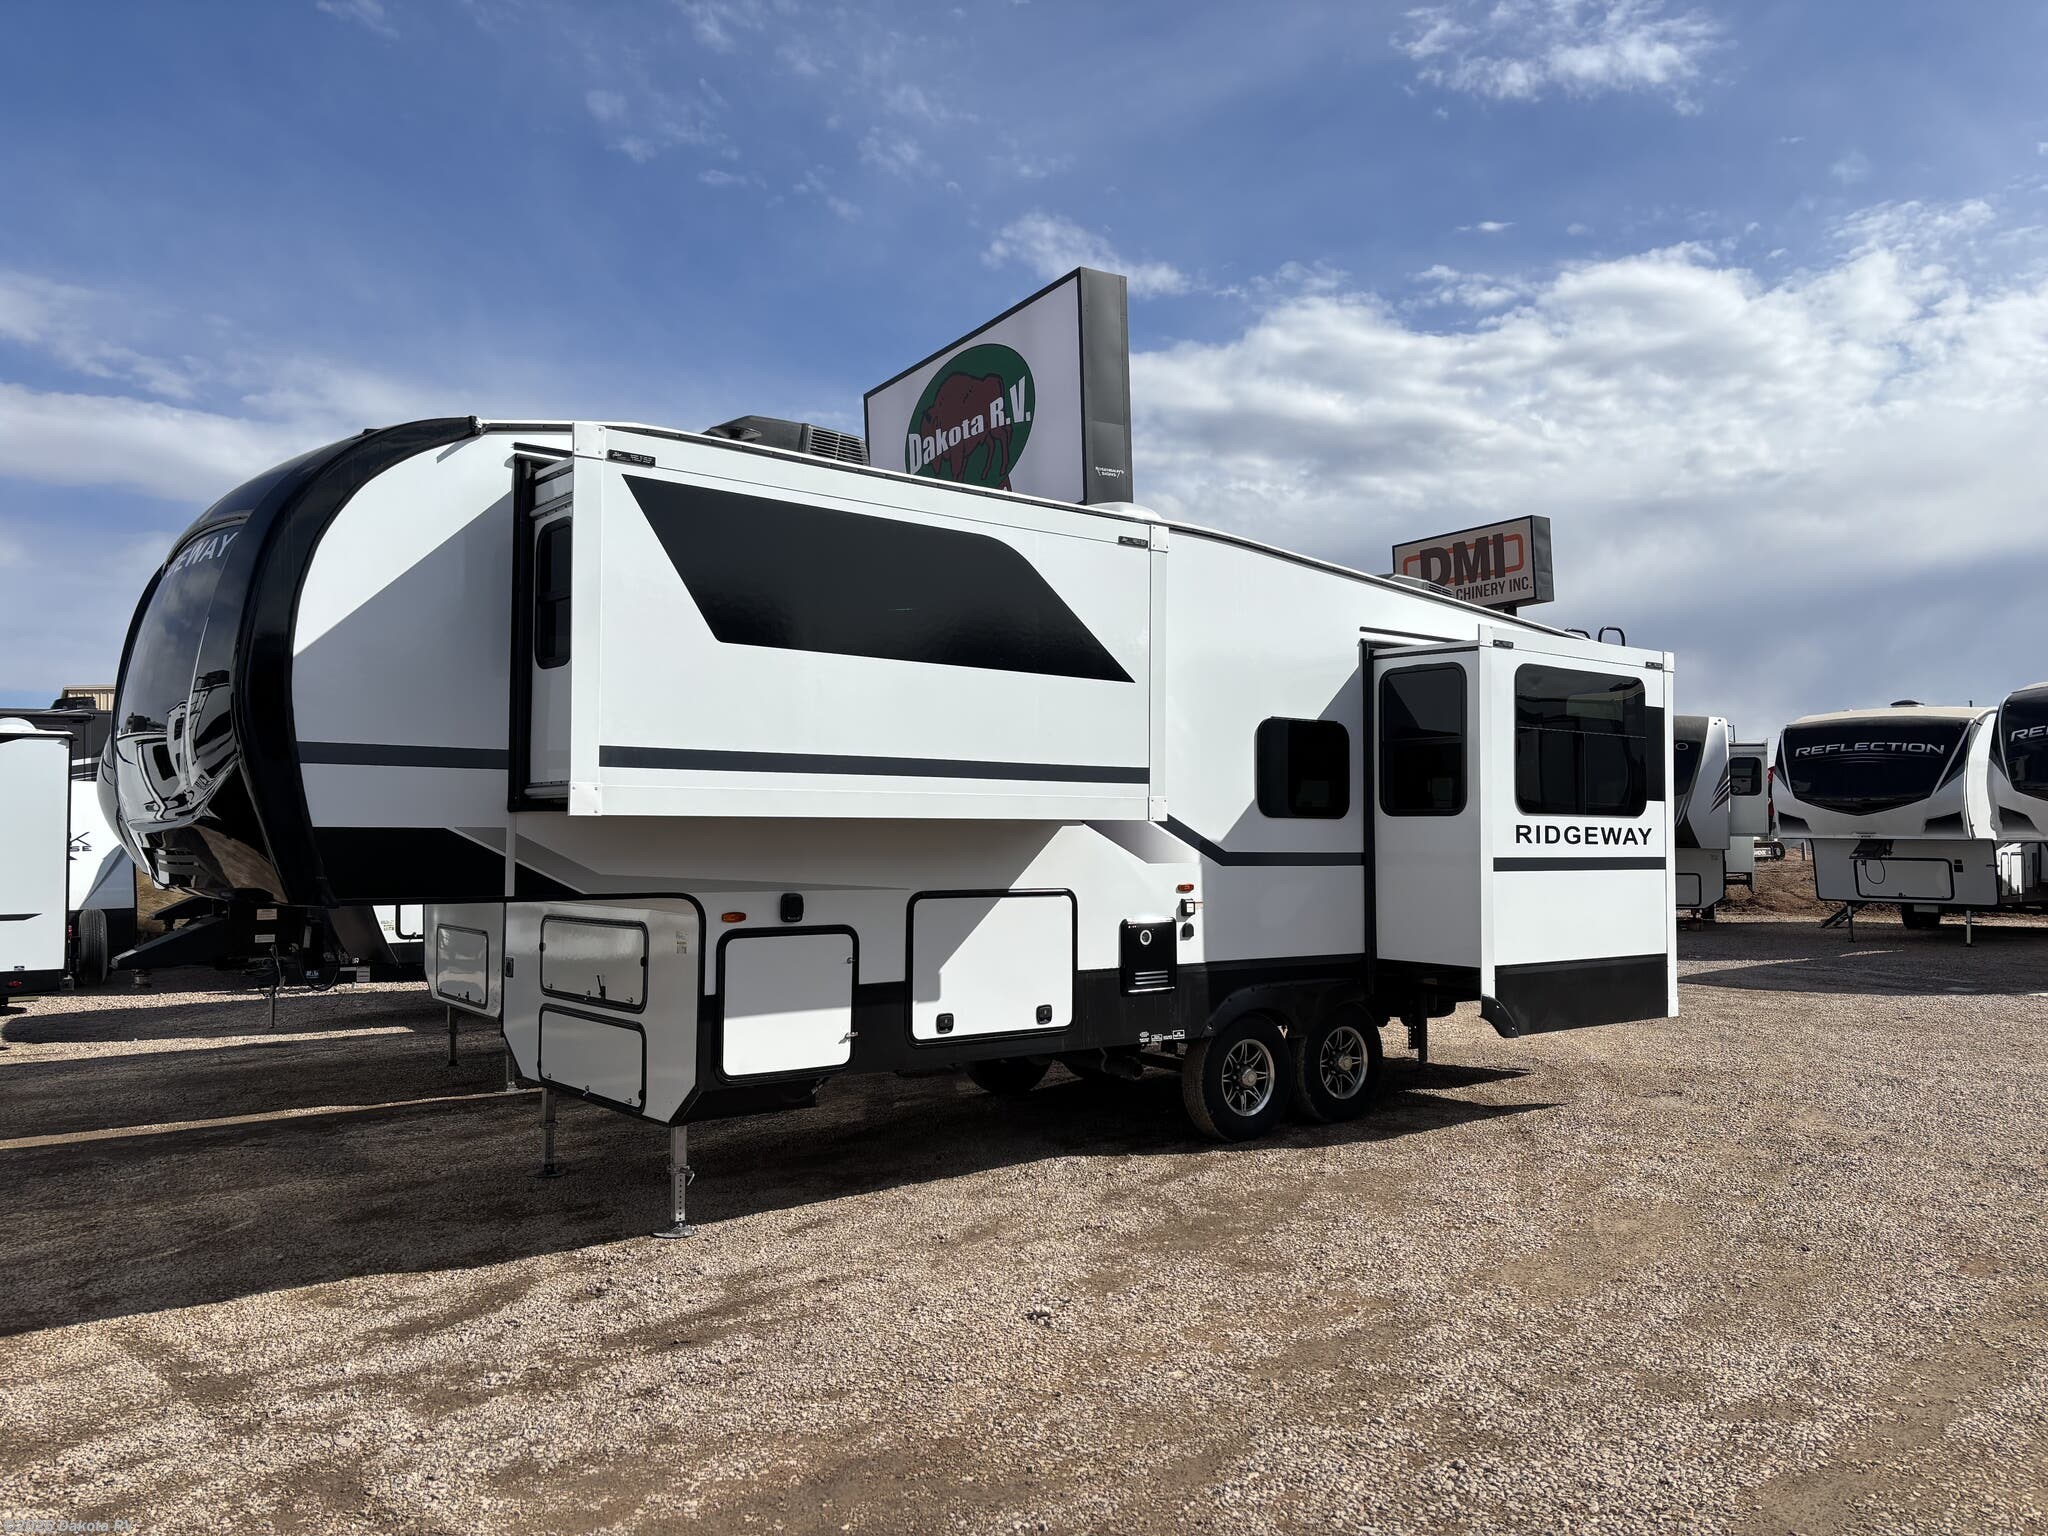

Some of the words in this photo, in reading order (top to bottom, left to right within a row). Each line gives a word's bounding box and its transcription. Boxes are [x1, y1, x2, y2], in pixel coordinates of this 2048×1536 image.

[908, 414, 984, 475] Dakota
[990, 376, 1031, 429] R.V.
[1420, 533, 1505, 586] DMI
[1455, 580, 1506, 600] CHINERY
[1509, 576, 1533, 593] INC.
[2010, 725, 2048, 742] RE
[1795, 742, 1944, 757] REFLECTION
[1515, 824, 1652, 845] RIDGEWAY
